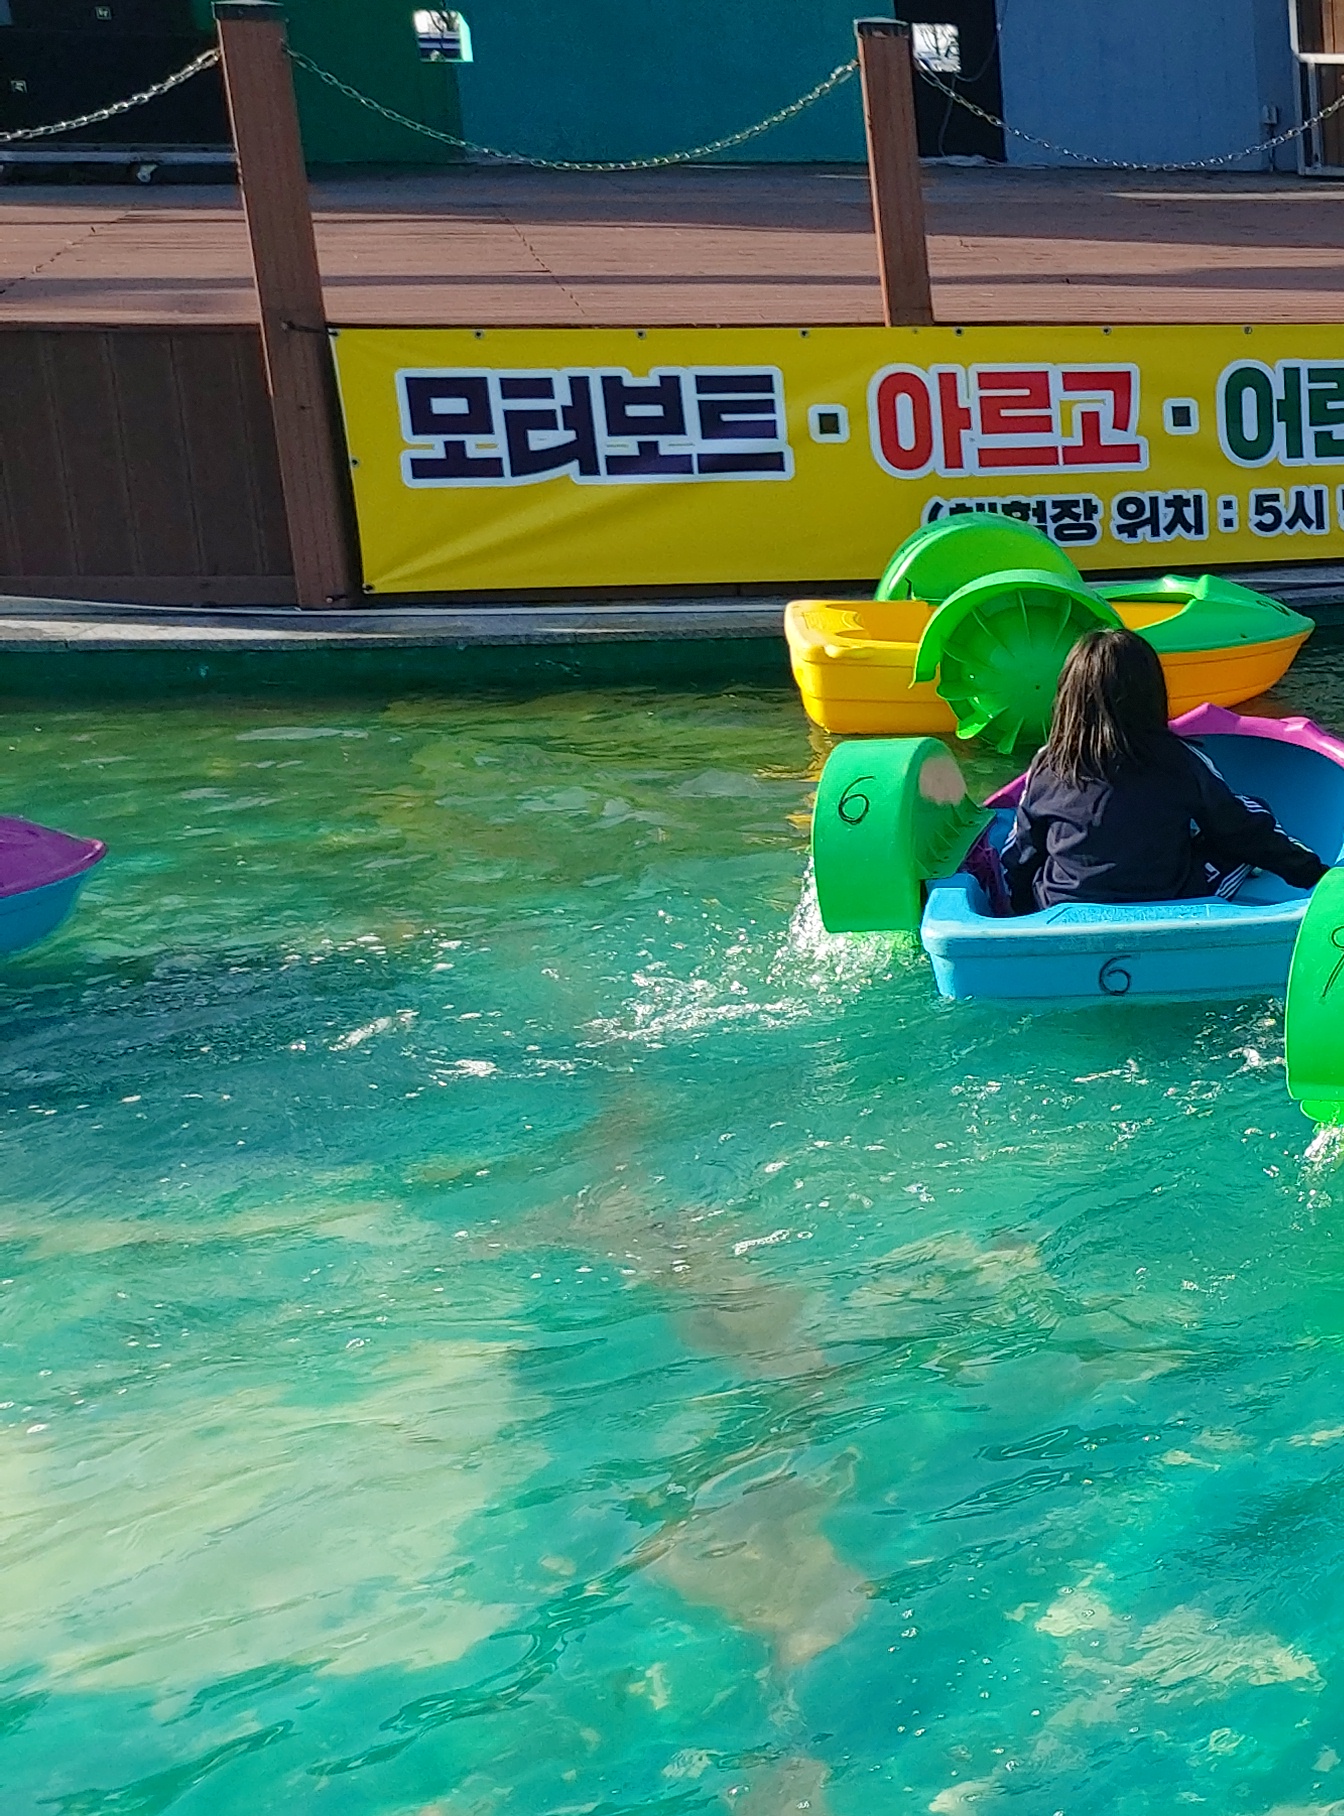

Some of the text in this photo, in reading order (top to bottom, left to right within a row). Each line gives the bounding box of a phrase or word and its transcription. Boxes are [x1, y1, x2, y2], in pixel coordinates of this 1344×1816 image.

[405, 375, 786, 479] 모터보트
[878, 371, 1142, 471] 아르고
[1114, 493, 1204, 538] 위치
[1254, 490, 1326, 533] 5시
[838, 775, 876, 826] 6
[1098, 954, 1132, 998] 6
